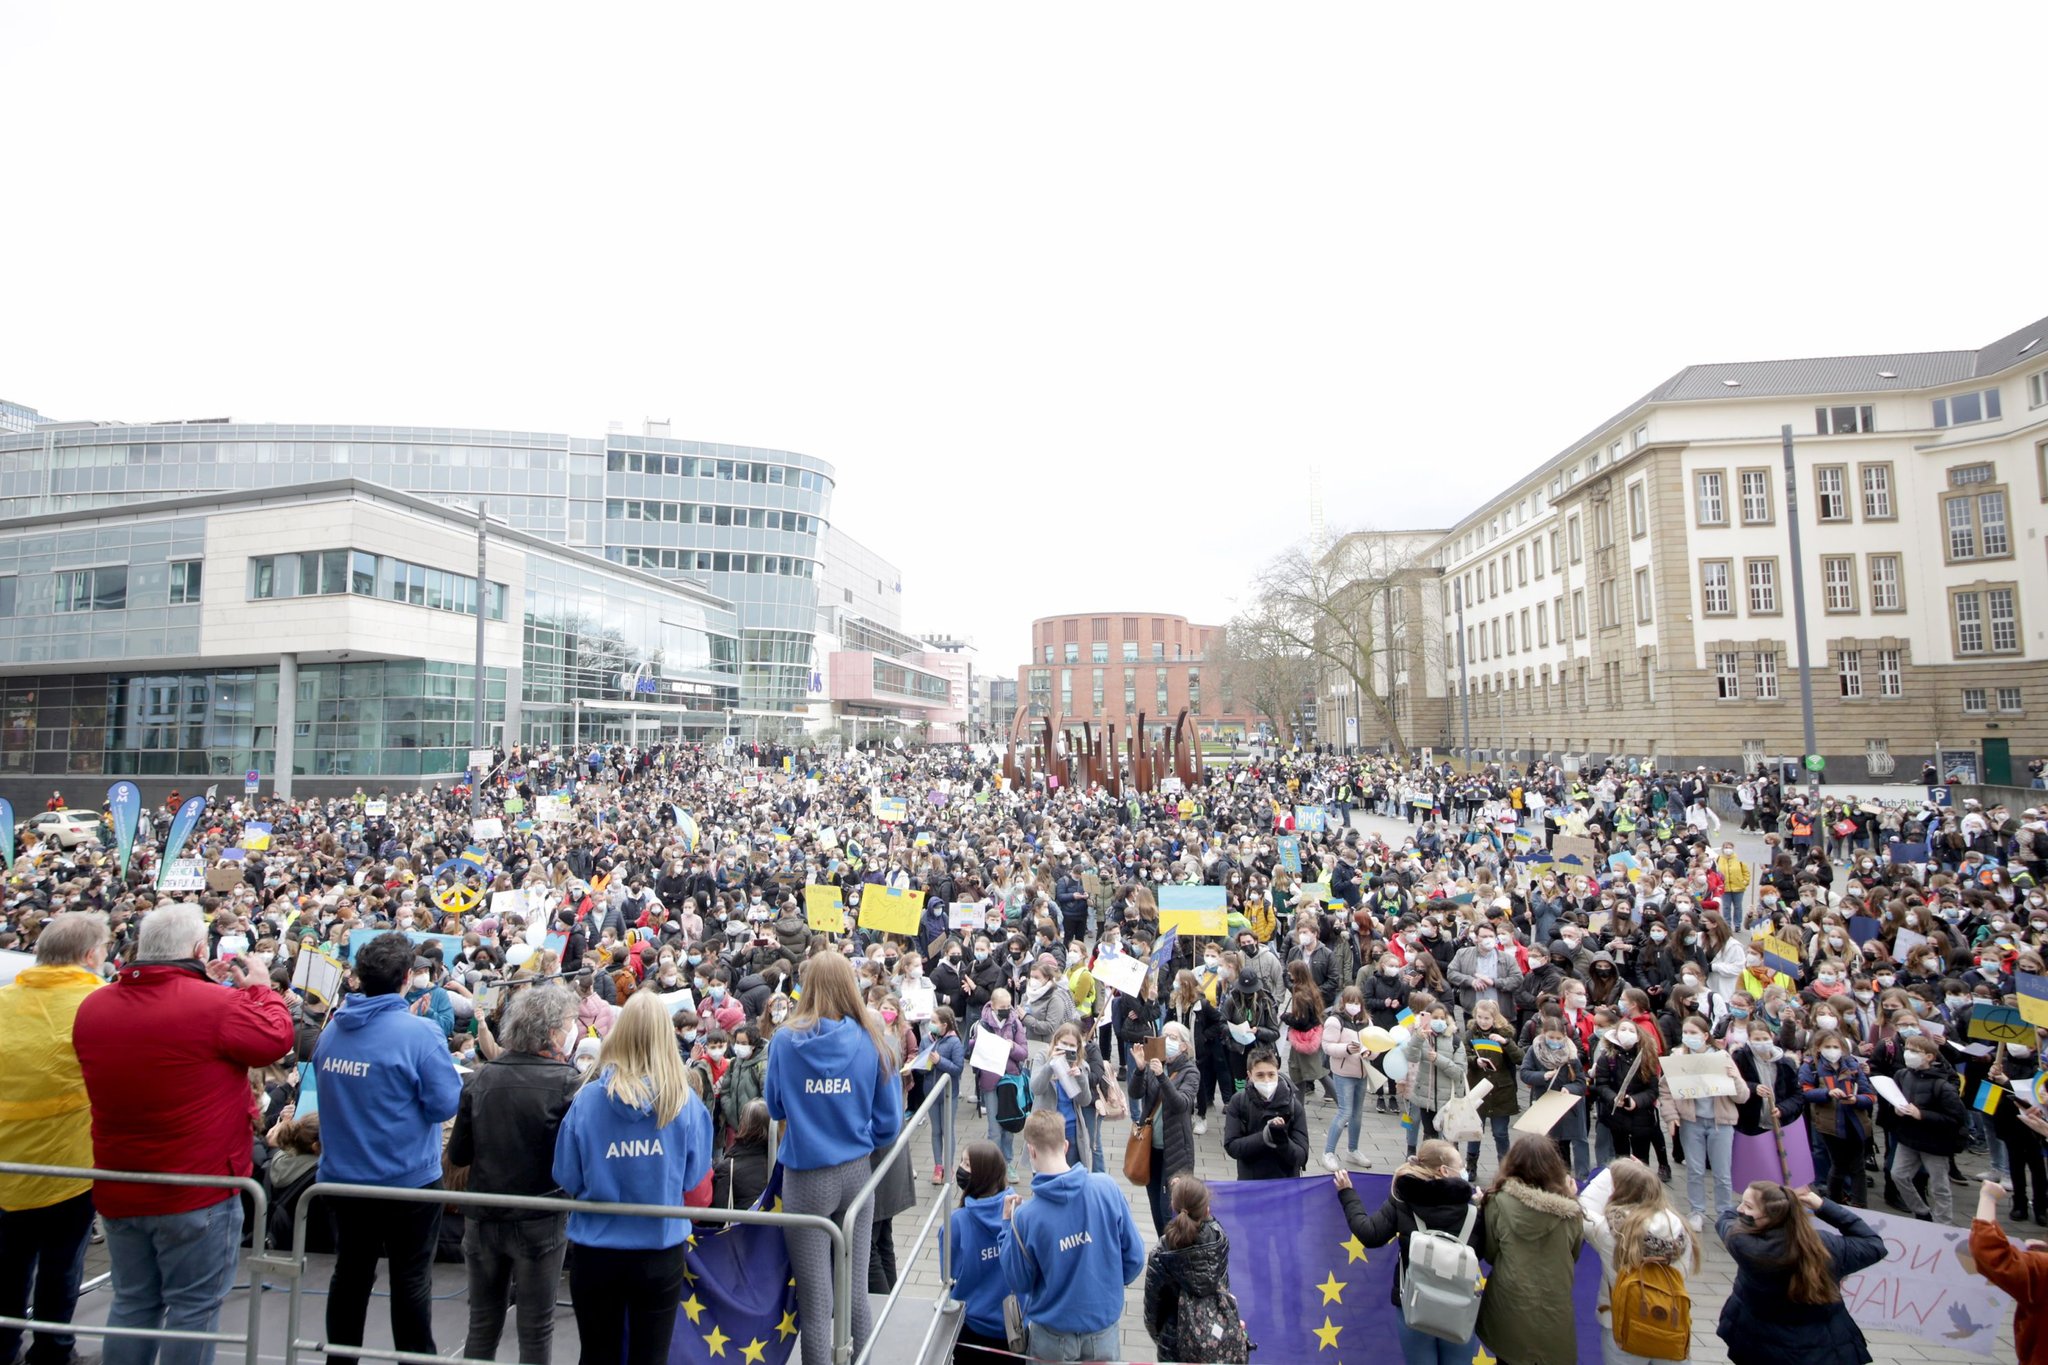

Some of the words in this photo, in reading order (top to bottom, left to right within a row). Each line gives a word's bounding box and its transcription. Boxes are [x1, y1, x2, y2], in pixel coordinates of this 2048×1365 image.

[1936, 792, 1946, 804] P
[1298, 812, 1321, 825] MMG
[322, 1057, 370, 1077] AHMET
[805, 1078, 851, 1094] RABEA
[606, 1139, 664, 1159] ANNA
[1060, 1231, 1092, 1252] MIKA
